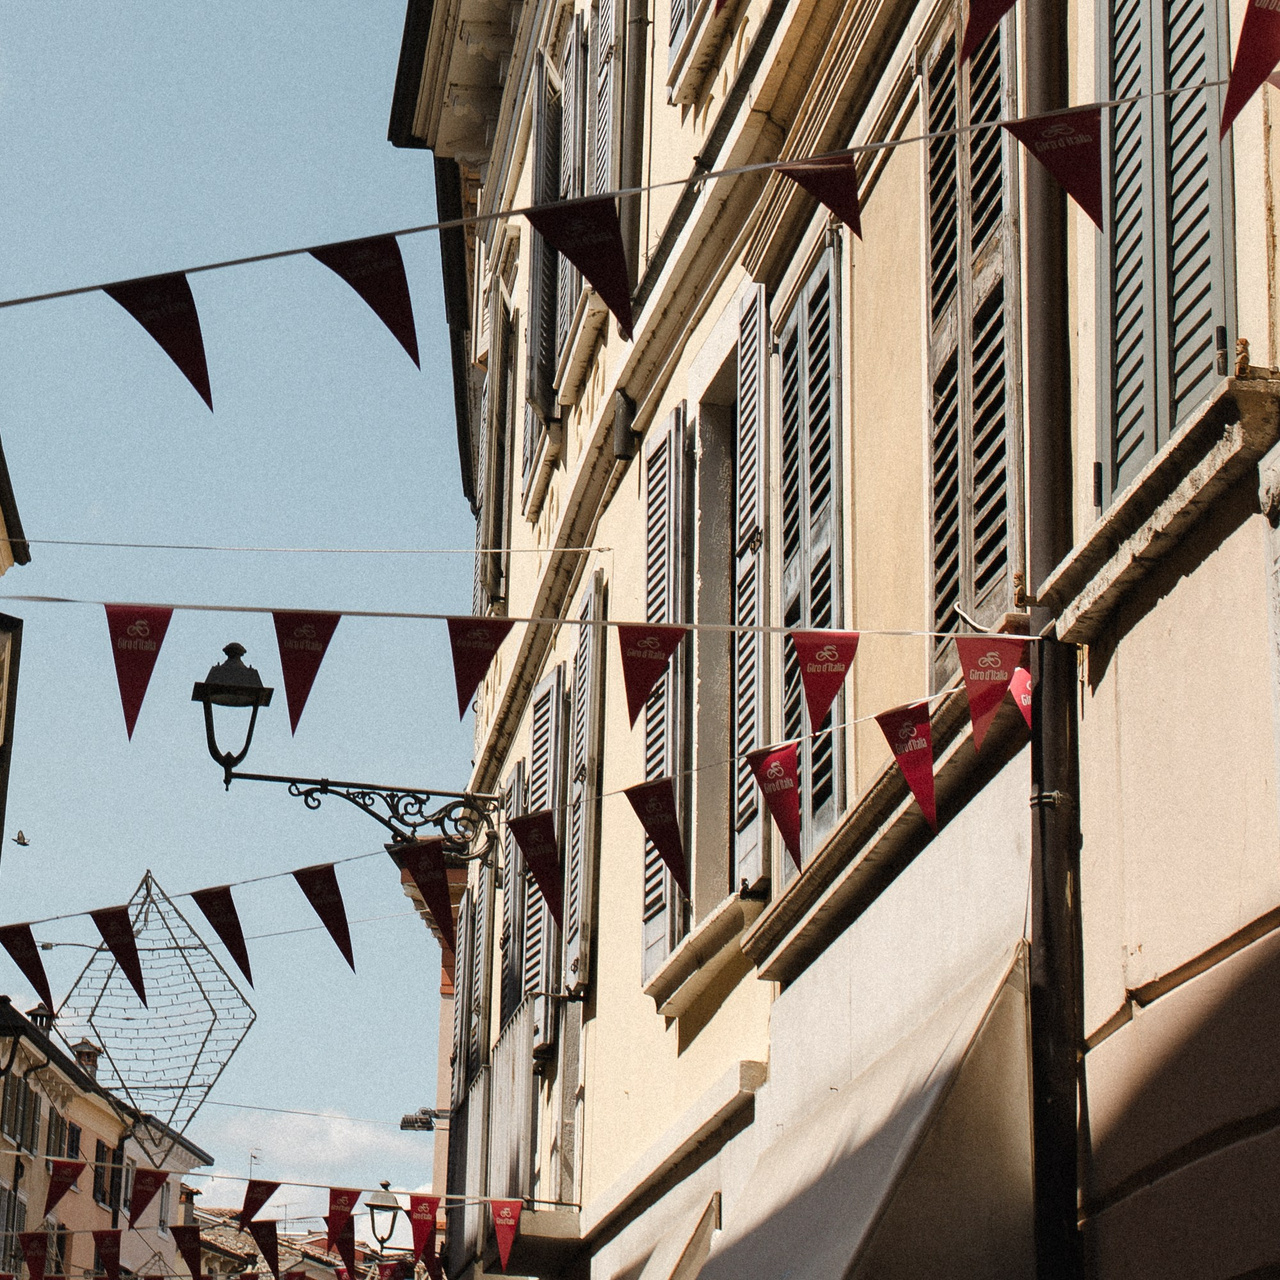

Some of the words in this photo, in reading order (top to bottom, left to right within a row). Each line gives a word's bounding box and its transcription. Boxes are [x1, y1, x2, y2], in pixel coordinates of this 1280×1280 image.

[807, 662, 821, 673] Giro
[822, 661, 846, 673] d'Italia
[969, 669, 984, 680] Giro
[985, 669, 1008, 681] d'Italia
[895, 742, 909, 755] Giro
[908, 737, 927, 753] d'Italia
[763, 782, 777, 794] Giro
[776, 777, 794, 791] d'Italia
